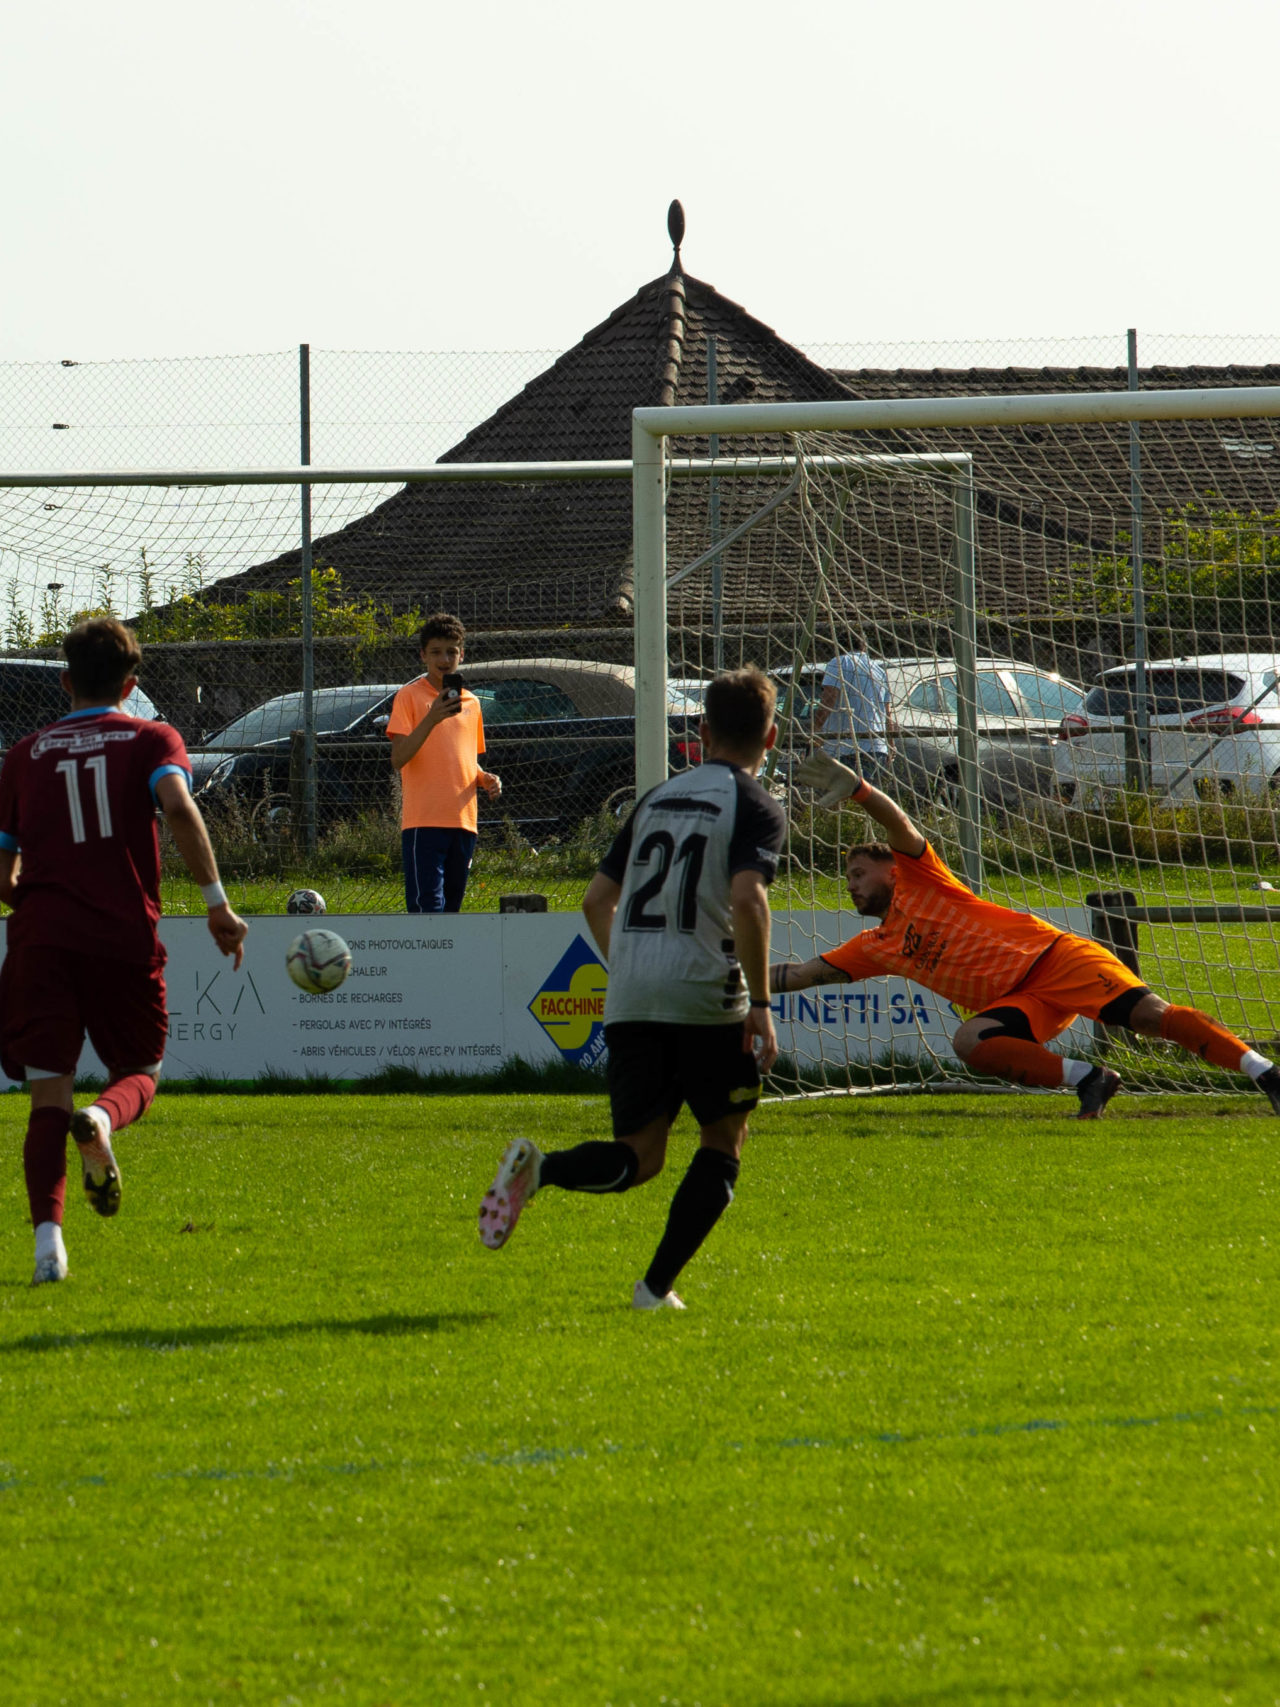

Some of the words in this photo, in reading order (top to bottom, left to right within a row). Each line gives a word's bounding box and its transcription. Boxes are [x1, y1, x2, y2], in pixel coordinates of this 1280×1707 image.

[55, 755, 113, 844] 11
[623, 830, 708, 934] 21
[368, 939, 453, 950] PHOTOVOLTAIQUES
[299, 993, 334, 1004] BORNES
[336, 993, 347, 1003] DE
[350, 993, 403, 1003] RECHARGES
[540, 998, 604, 1015] FACCHINE
[771, 993, 880, 1024] HINETTI
[891, 993, 930, 1024] SA
[300, 1020, 346, 1030] PERGOLAS
[349, 1020, 371, 1029] AVEC
[374, 1019, 386, 1029] PV
[389, 1018, 431, 1029] INTÉGRÉS
[300, 1046, 326, 1056] ABRIS
[328, 1044, 376, 1056] VÉHICULES
[386, 1044, 415, 1056] VÉLOS
[419, 1046, 441, 1056] AVEC
[444, 1046, 456, 1056] PV
[458, 1044, 502, 1056] INTÉGRÉS
